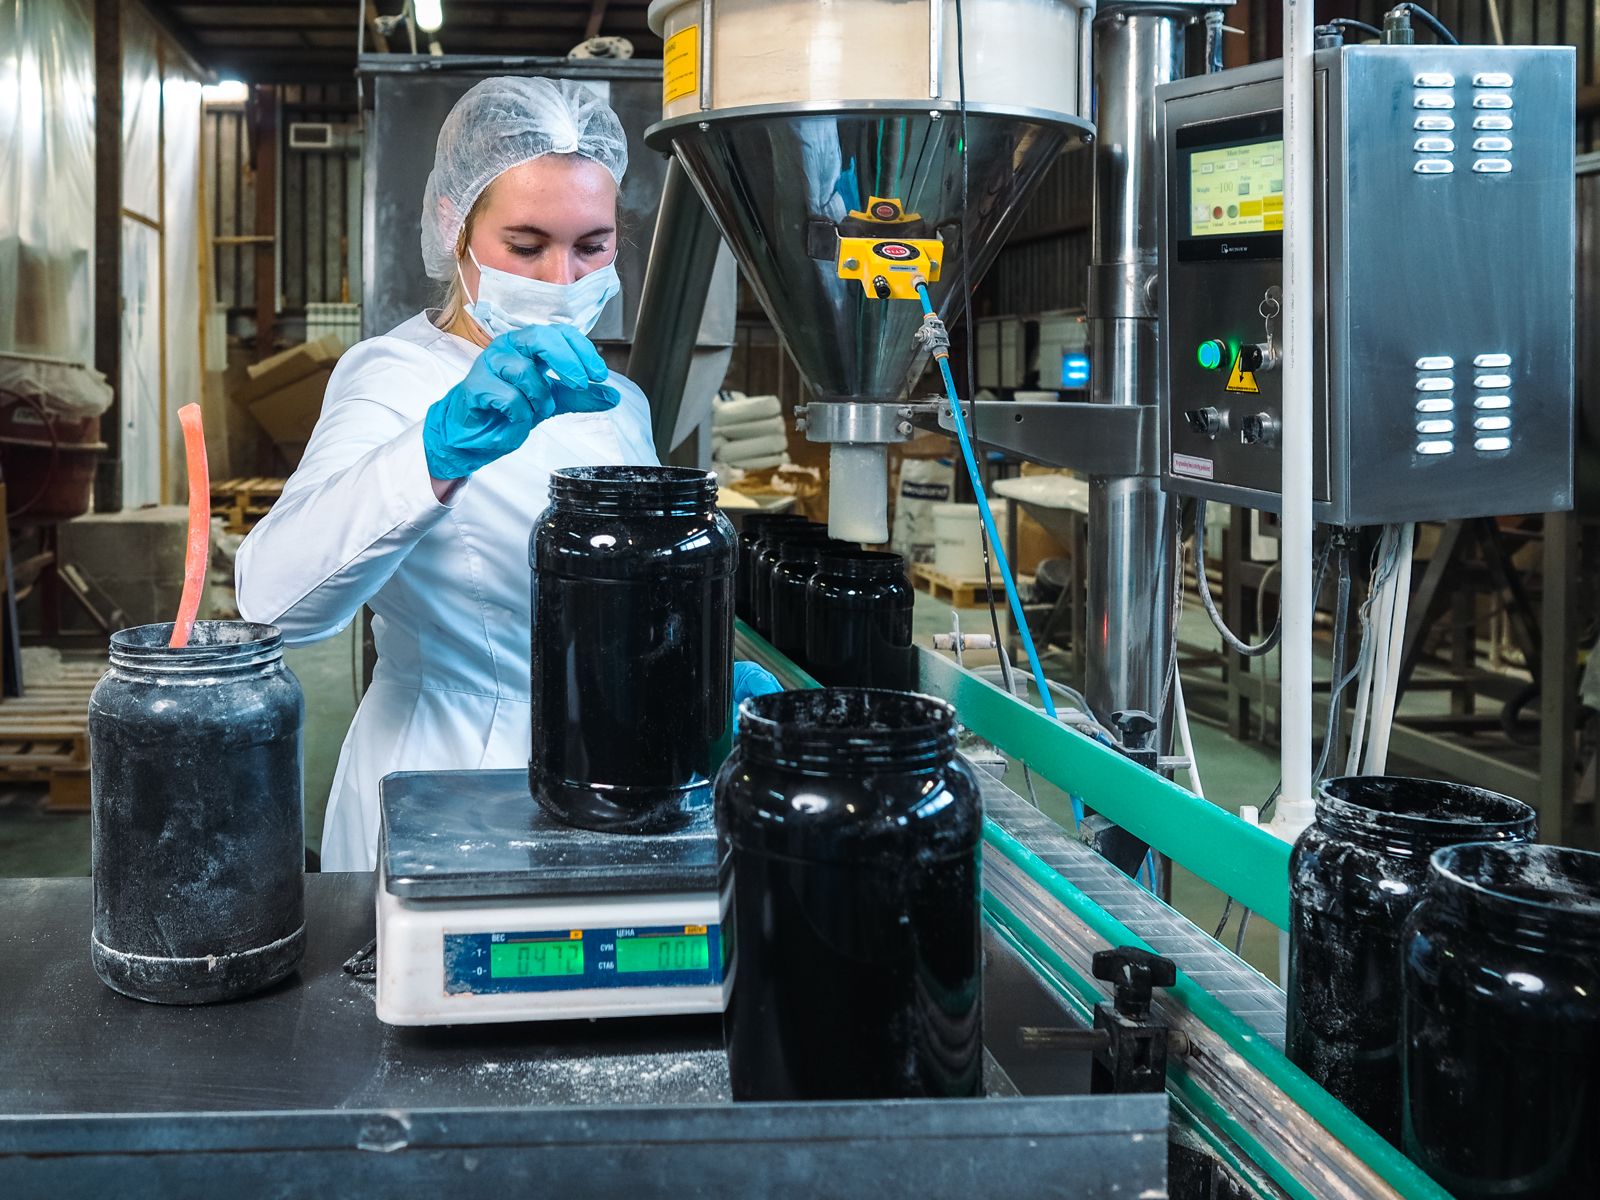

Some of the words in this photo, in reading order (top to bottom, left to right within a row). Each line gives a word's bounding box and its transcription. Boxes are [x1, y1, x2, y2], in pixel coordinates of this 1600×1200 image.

[491, 933, 505, 942] ВЕС
[616, 928, 635, 938] ЦЕНА
[598, 961, 615, 970] СТАБ
